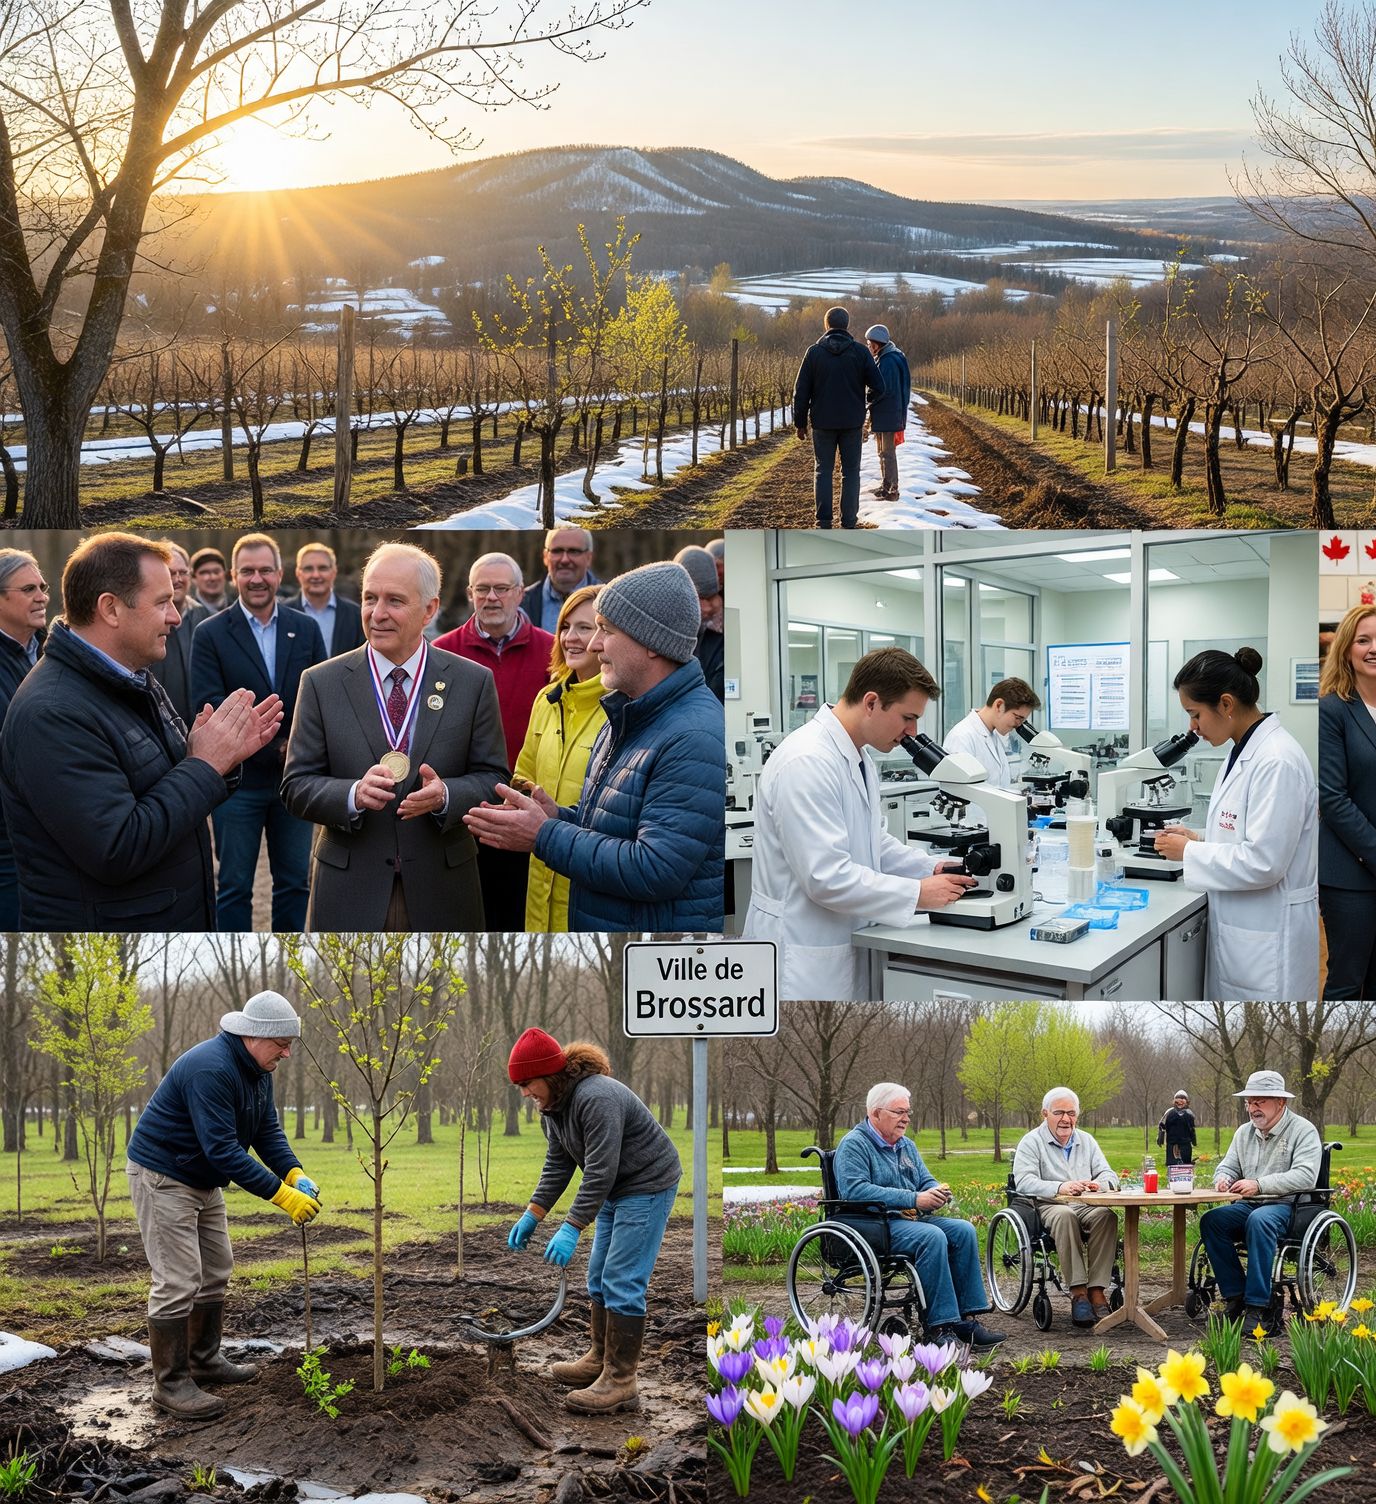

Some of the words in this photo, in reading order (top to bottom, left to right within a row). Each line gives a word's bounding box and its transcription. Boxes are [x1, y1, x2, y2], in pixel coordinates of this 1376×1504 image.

[657, 957, 707, 980] Ville
[715, 957, 743, 980] de
[636, 988, 765, 1019] Brossard
